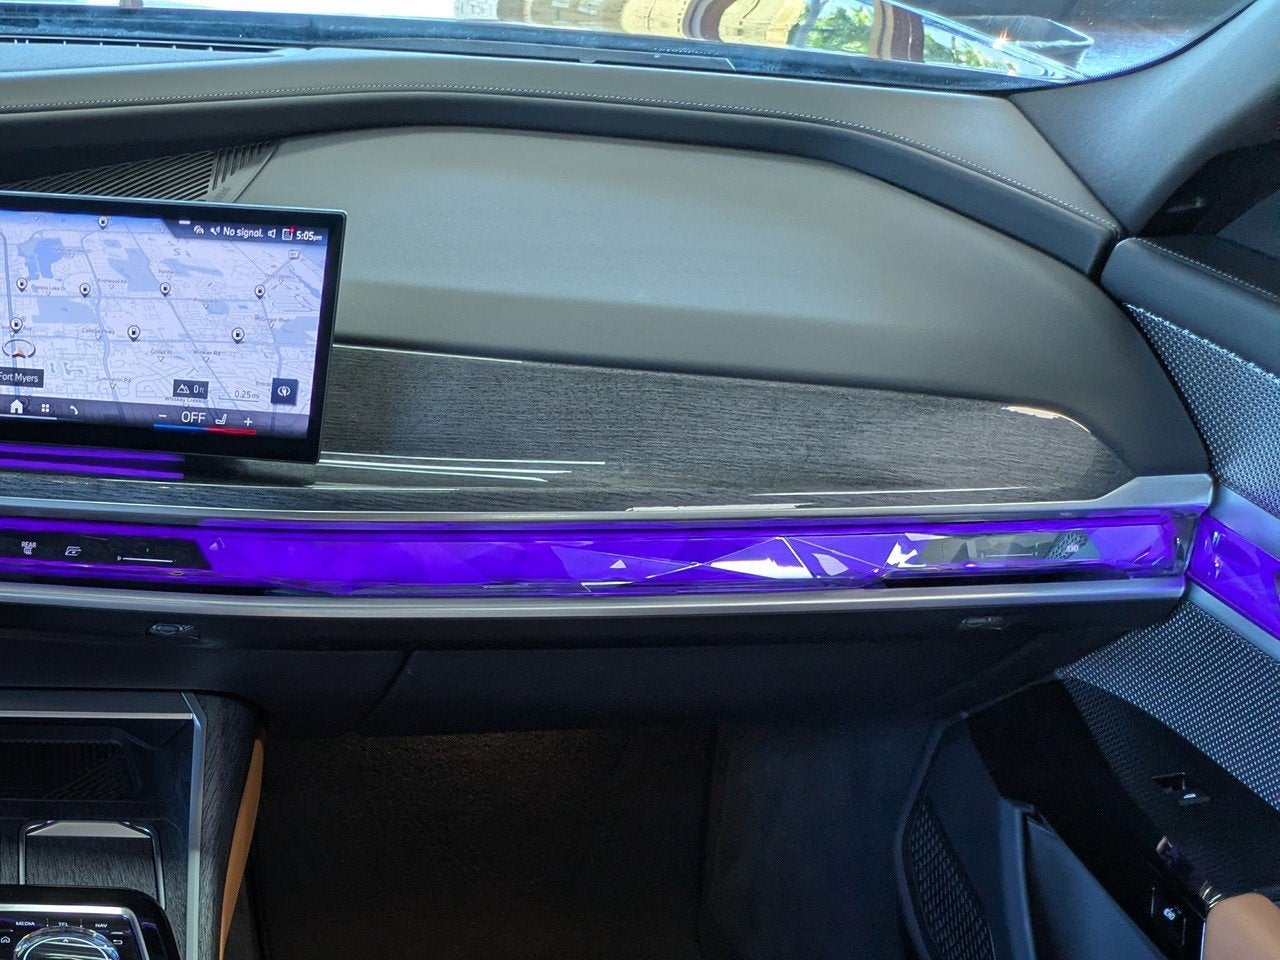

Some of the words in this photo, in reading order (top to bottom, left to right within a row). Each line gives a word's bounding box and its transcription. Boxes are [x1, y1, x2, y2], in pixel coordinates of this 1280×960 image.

[223, 227, 235, 236] No
[237, 228, 263, 238] signal.
[296, 231, 322, 241] 5:05pm
[15, 373, 39, 383] Myers
[234, 390, 251, 399] 0.25
[181, 411, 206, 423] OFF
